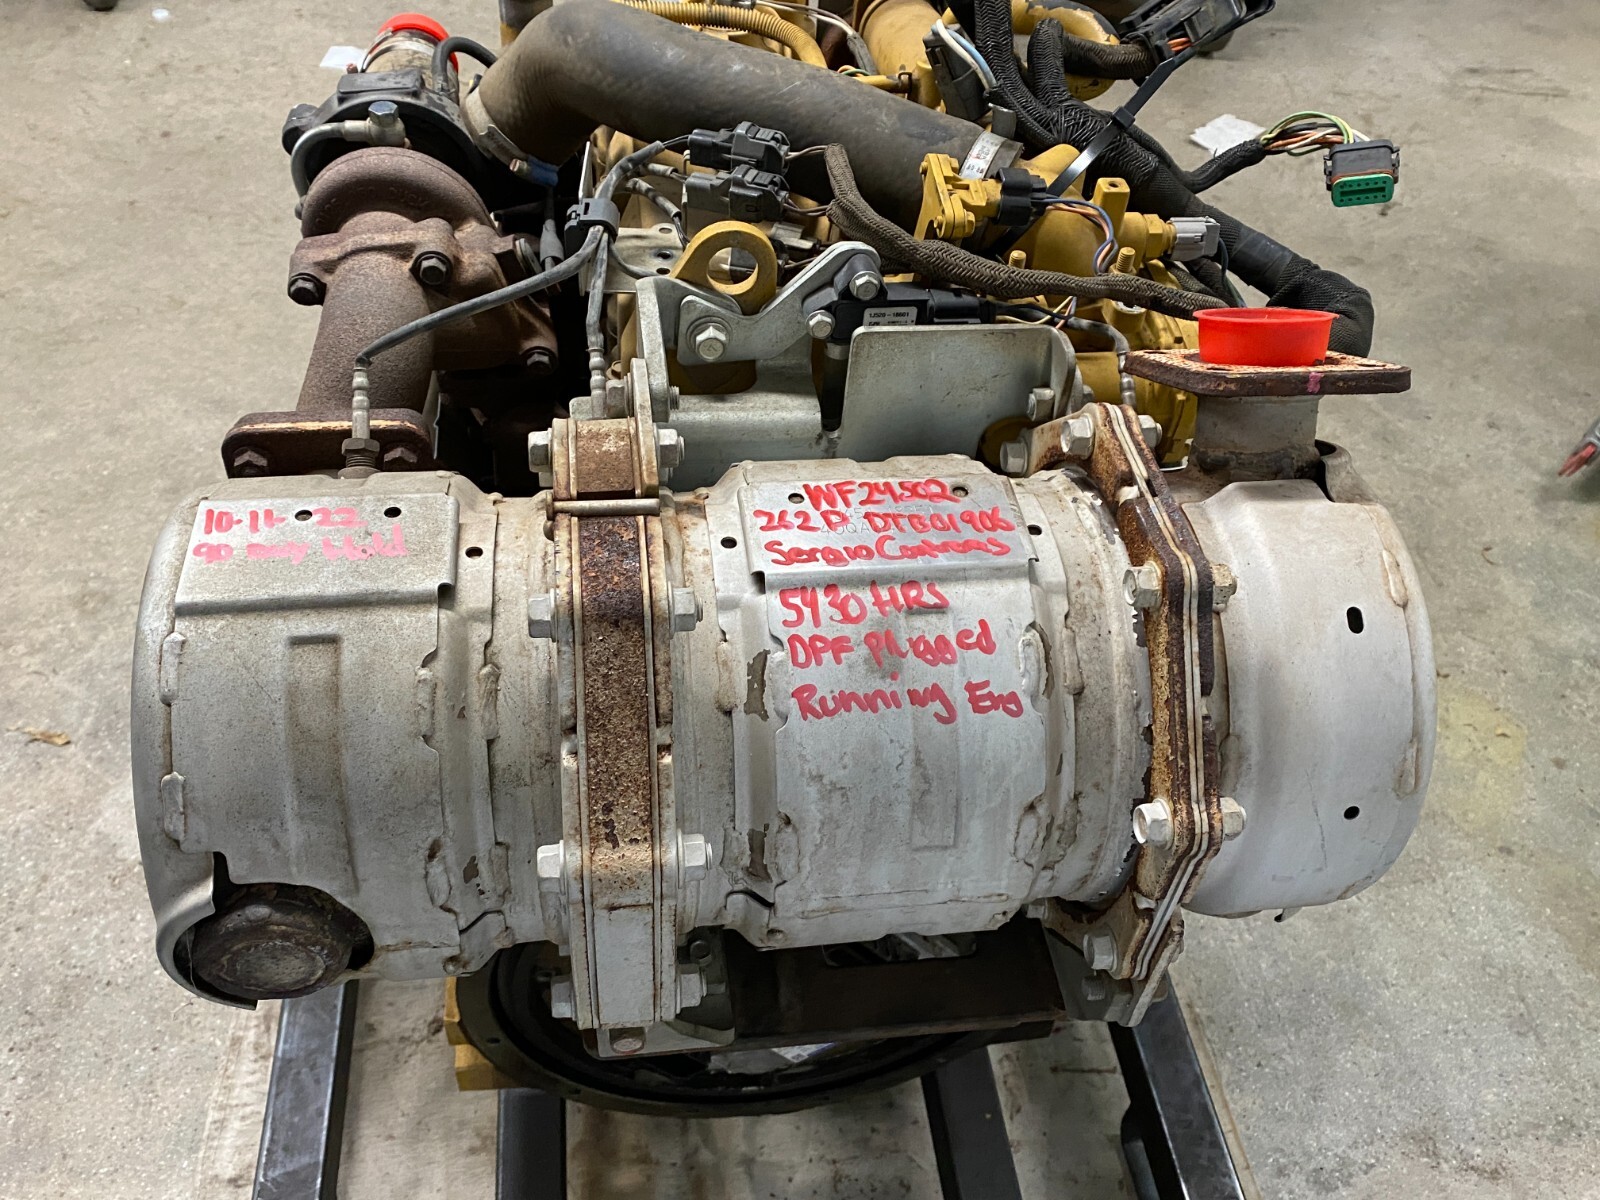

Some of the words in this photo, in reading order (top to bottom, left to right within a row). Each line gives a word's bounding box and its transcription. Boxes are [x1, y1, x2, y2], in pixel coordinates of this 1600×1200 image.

[193, 542, 234, 564] 90
[778, 583, 867, 629] 5430
[869, 580, 949, 617] HRS
[787, 633, 855, 669] DPF
[791, 671, 957, 725] Running
[964, 680, 1023, 718] Eng
